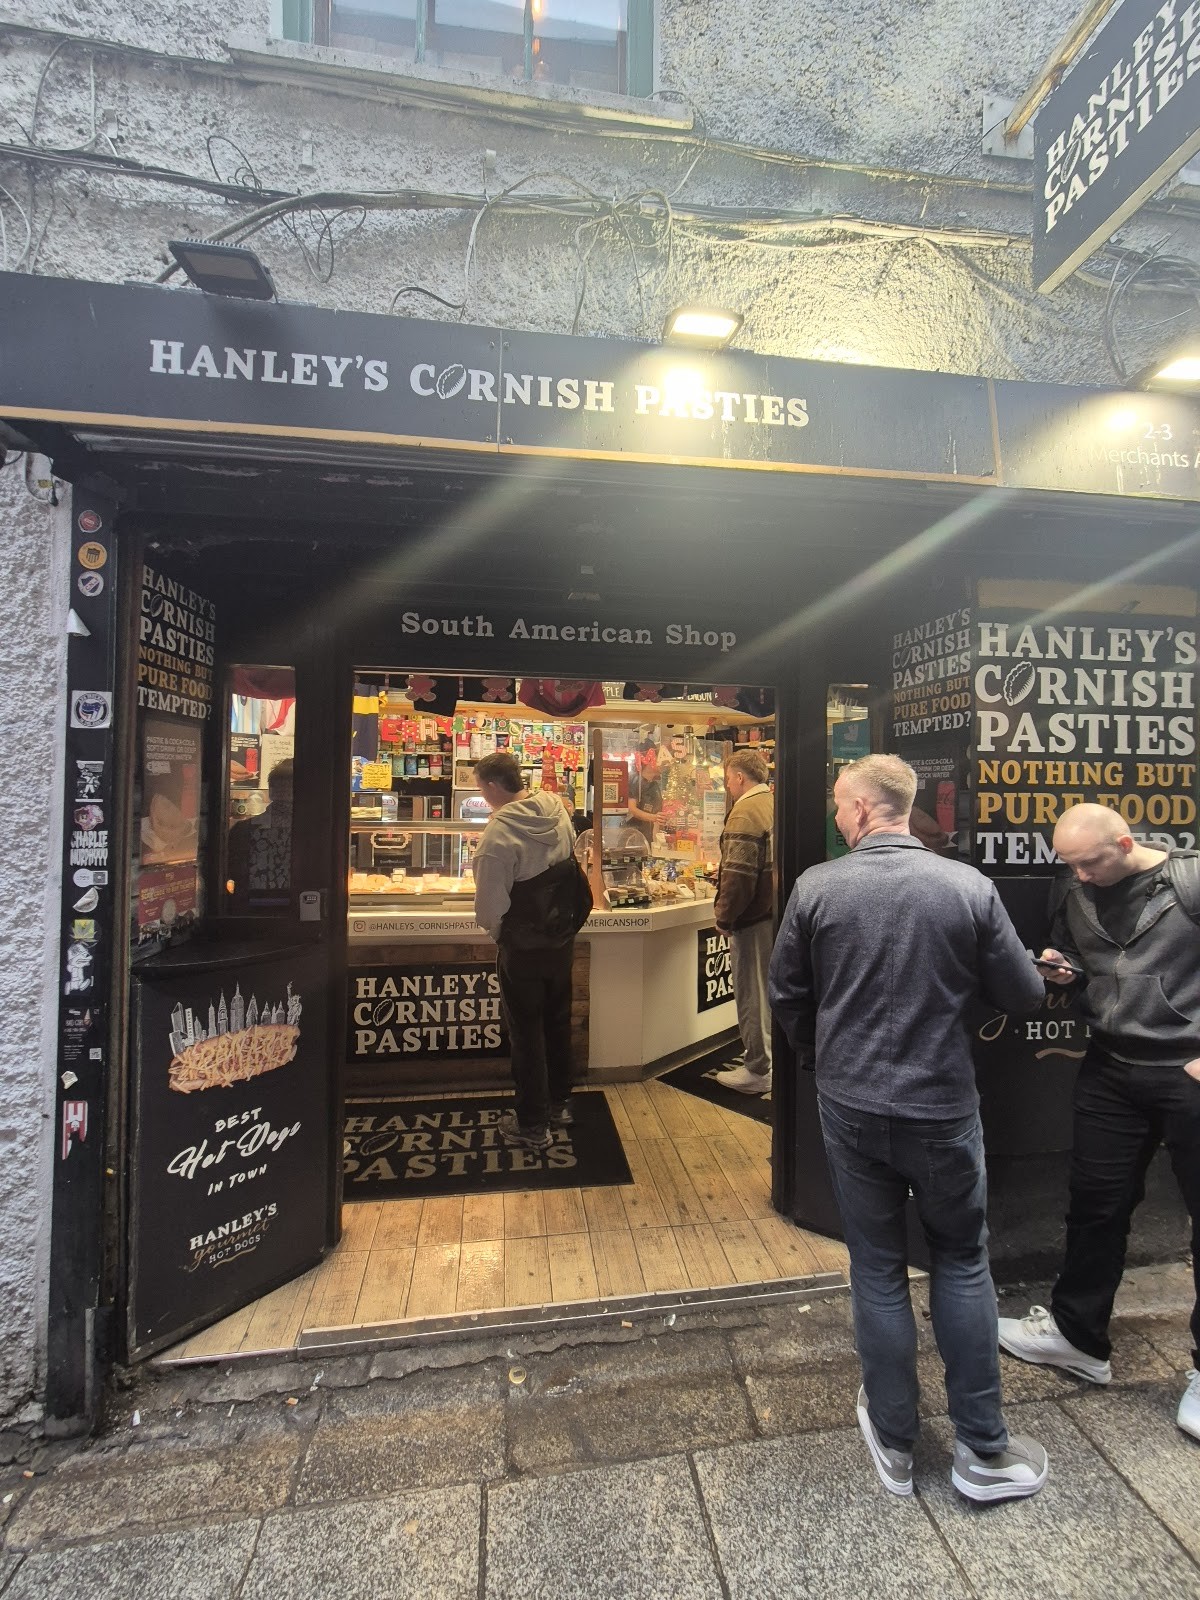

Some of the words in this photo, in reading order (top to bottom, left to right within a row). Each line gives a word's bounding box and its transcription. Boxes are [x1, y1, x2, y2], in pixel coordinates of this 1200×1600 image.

[149, 339, 389, 392] HANLEY'S
[409, 362, 614, 412] CORNISH
[635, 381, 809, 428] PASTIES
[1143, 422, 1173, 440] 2-3
[1089, 445, 1189, 468] Merchants
[142, 565, 216, 621] HANLEY'S
[141, 589, 215, 643] CORNISH
[401, 611, 494, 638] South
[508, 617, 653, 645] American
[665, 623, 737, 652] Shop
[893, 607, 971, 650] HANLEY'S
[140, 615, 215, 667] PASTIES
[893, 628, 971, 669] CORNISH
[978, 622, 1198, 665] HANLEY'S
[137, 663, 178, 690] PURE
[181, 673, 214, 701] FOOD
[138, 644, 191, 675] NOTHING
[195, 664, 213, 682] BUT
[893, 651, 971, 690] PASTIES
[137, 686, 212, 721] TEMPTED?
[893, 682, 942, 704] NOTHING
[946, 675, 970, 692] BUT
[975, 661, 1195, 709] CORNISH
[893, 700, 928, 721] PURE
[932, 691, 971, 714] FOOD
[893, 710, 972, 737] TEMPTED?
[976, 710, 1196, 756] PASTIES
[978, 759, 1124, 787] NOTHING
[1136, 763, 1196, 788] BUT
[355, 971, 500, 999] HANLEY'S
[354, 998, 501, 1027] CORNISH
[1026, 1020, 1075, 1040] HOT
[355, 1024, 502, 1055] PASTIES
[214, 1107, 262, 1133] BEST
[167, 1138, 235, 1180] Hot
[236, 1121, 301, 1157] Dogs
[207, 1180, 223, 1196] IN
[229, 1164, 267, 1188] TOWN
[189, 1202, 277, 1251] HANLEY'S
[208, 1246, 231, 1264] HOT
[234, 1233, 261, 1252] DOGS
